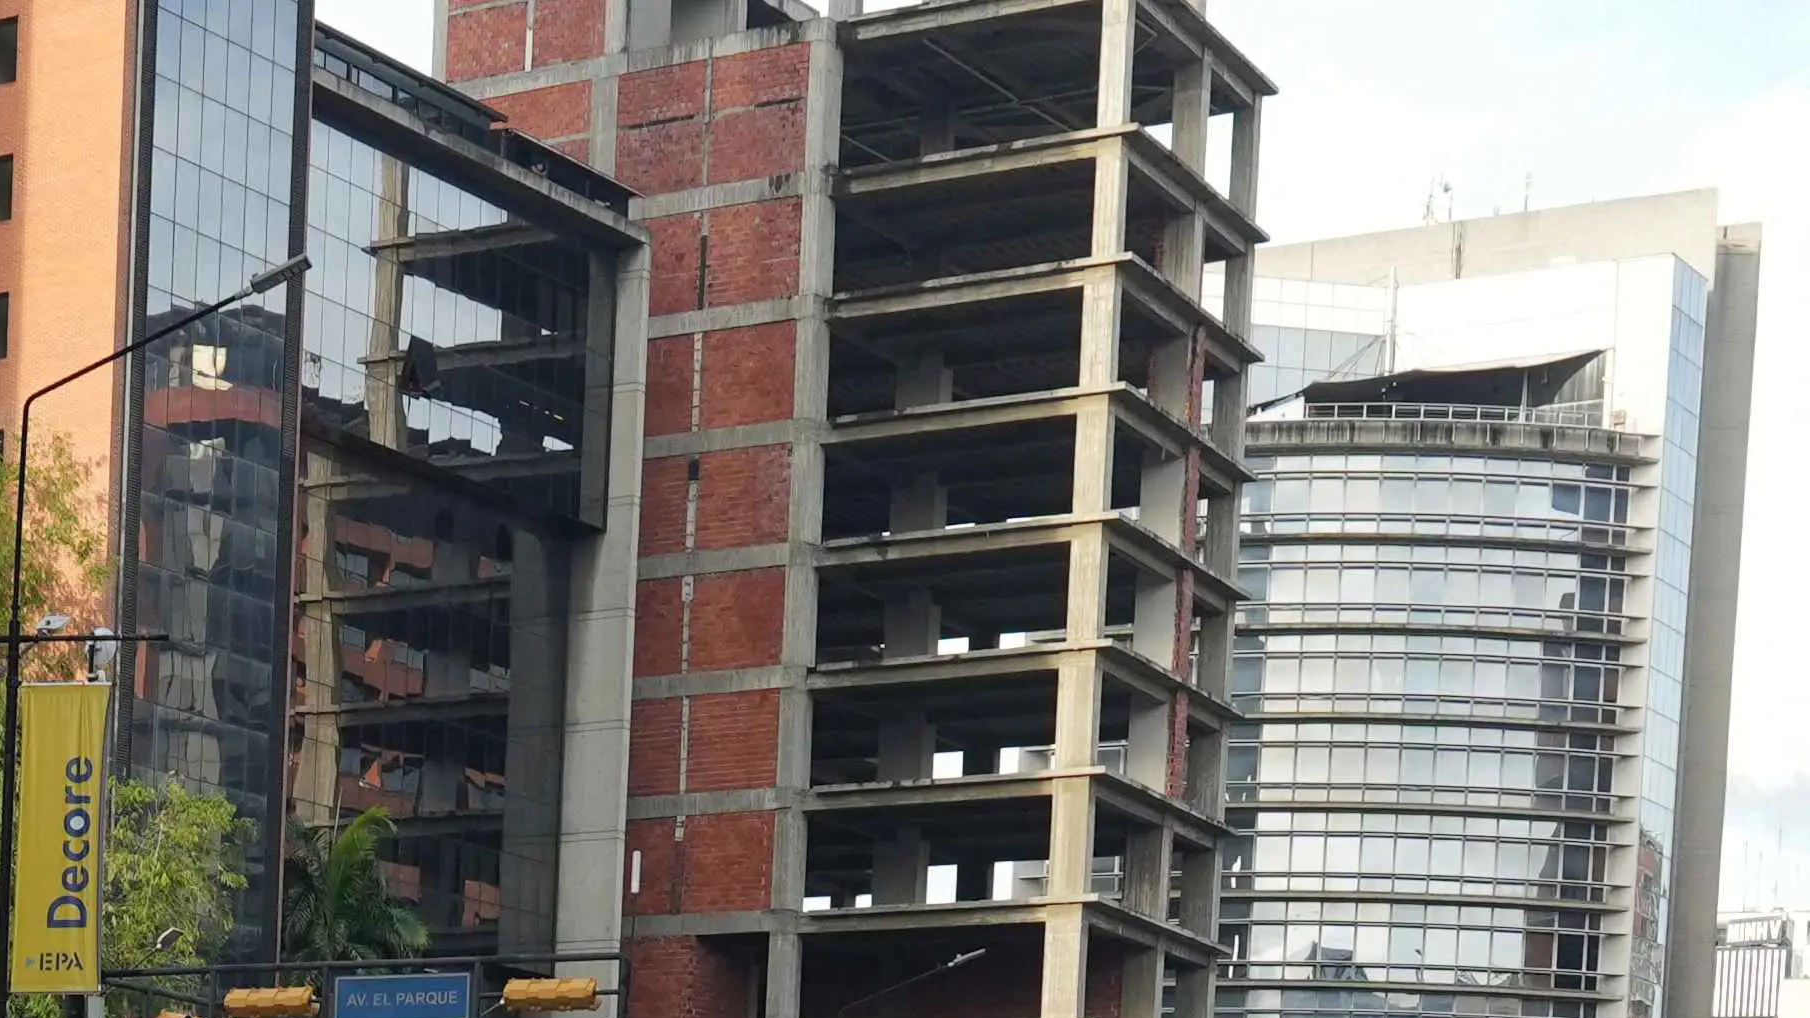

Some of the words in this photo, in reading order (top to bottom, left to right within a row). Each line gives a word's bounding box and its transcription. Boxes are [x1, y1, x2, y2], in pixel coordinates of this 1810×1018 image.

[47, 755, 93, 929] Decore
[40, 952, 83, 972] EPA
[347, 994, 368, 1008] AV.
[374, 993, 391, 1006] EL
[397, 990, 458, 1005] PARQUE
